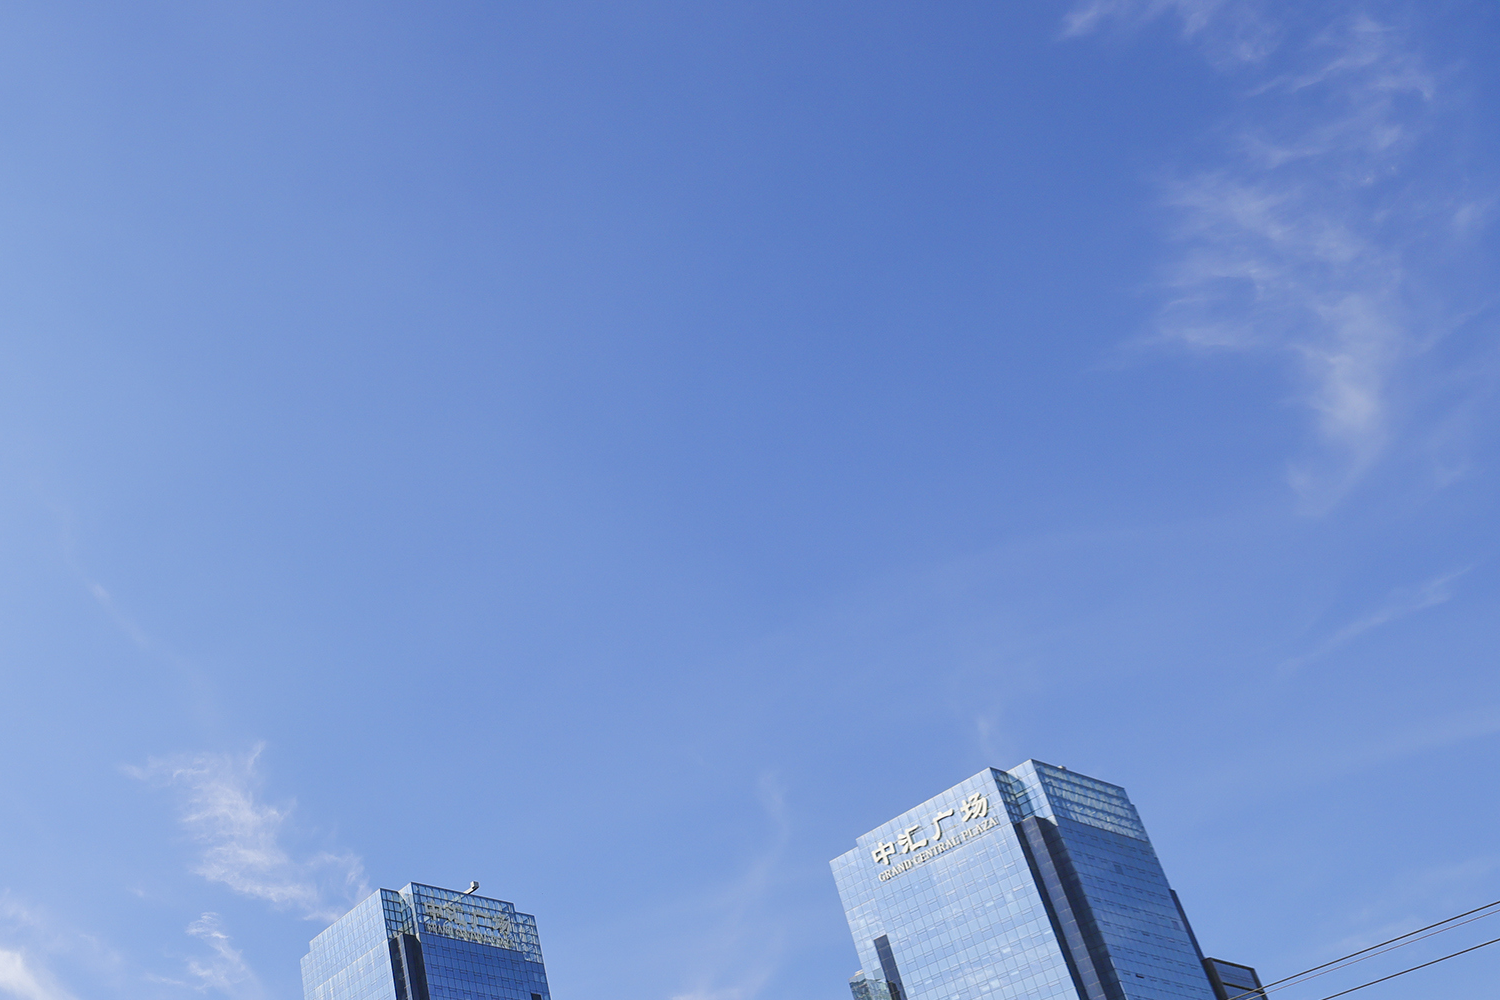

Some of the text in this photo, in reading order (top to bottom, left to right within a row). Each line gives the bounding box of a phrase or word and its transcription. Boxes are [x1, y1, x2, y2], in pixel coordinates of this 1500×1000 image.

[871, 792, 989, 866] 中汇广场
[878, 816, 1000, 882] GRAND CENTRAL PLAZA
